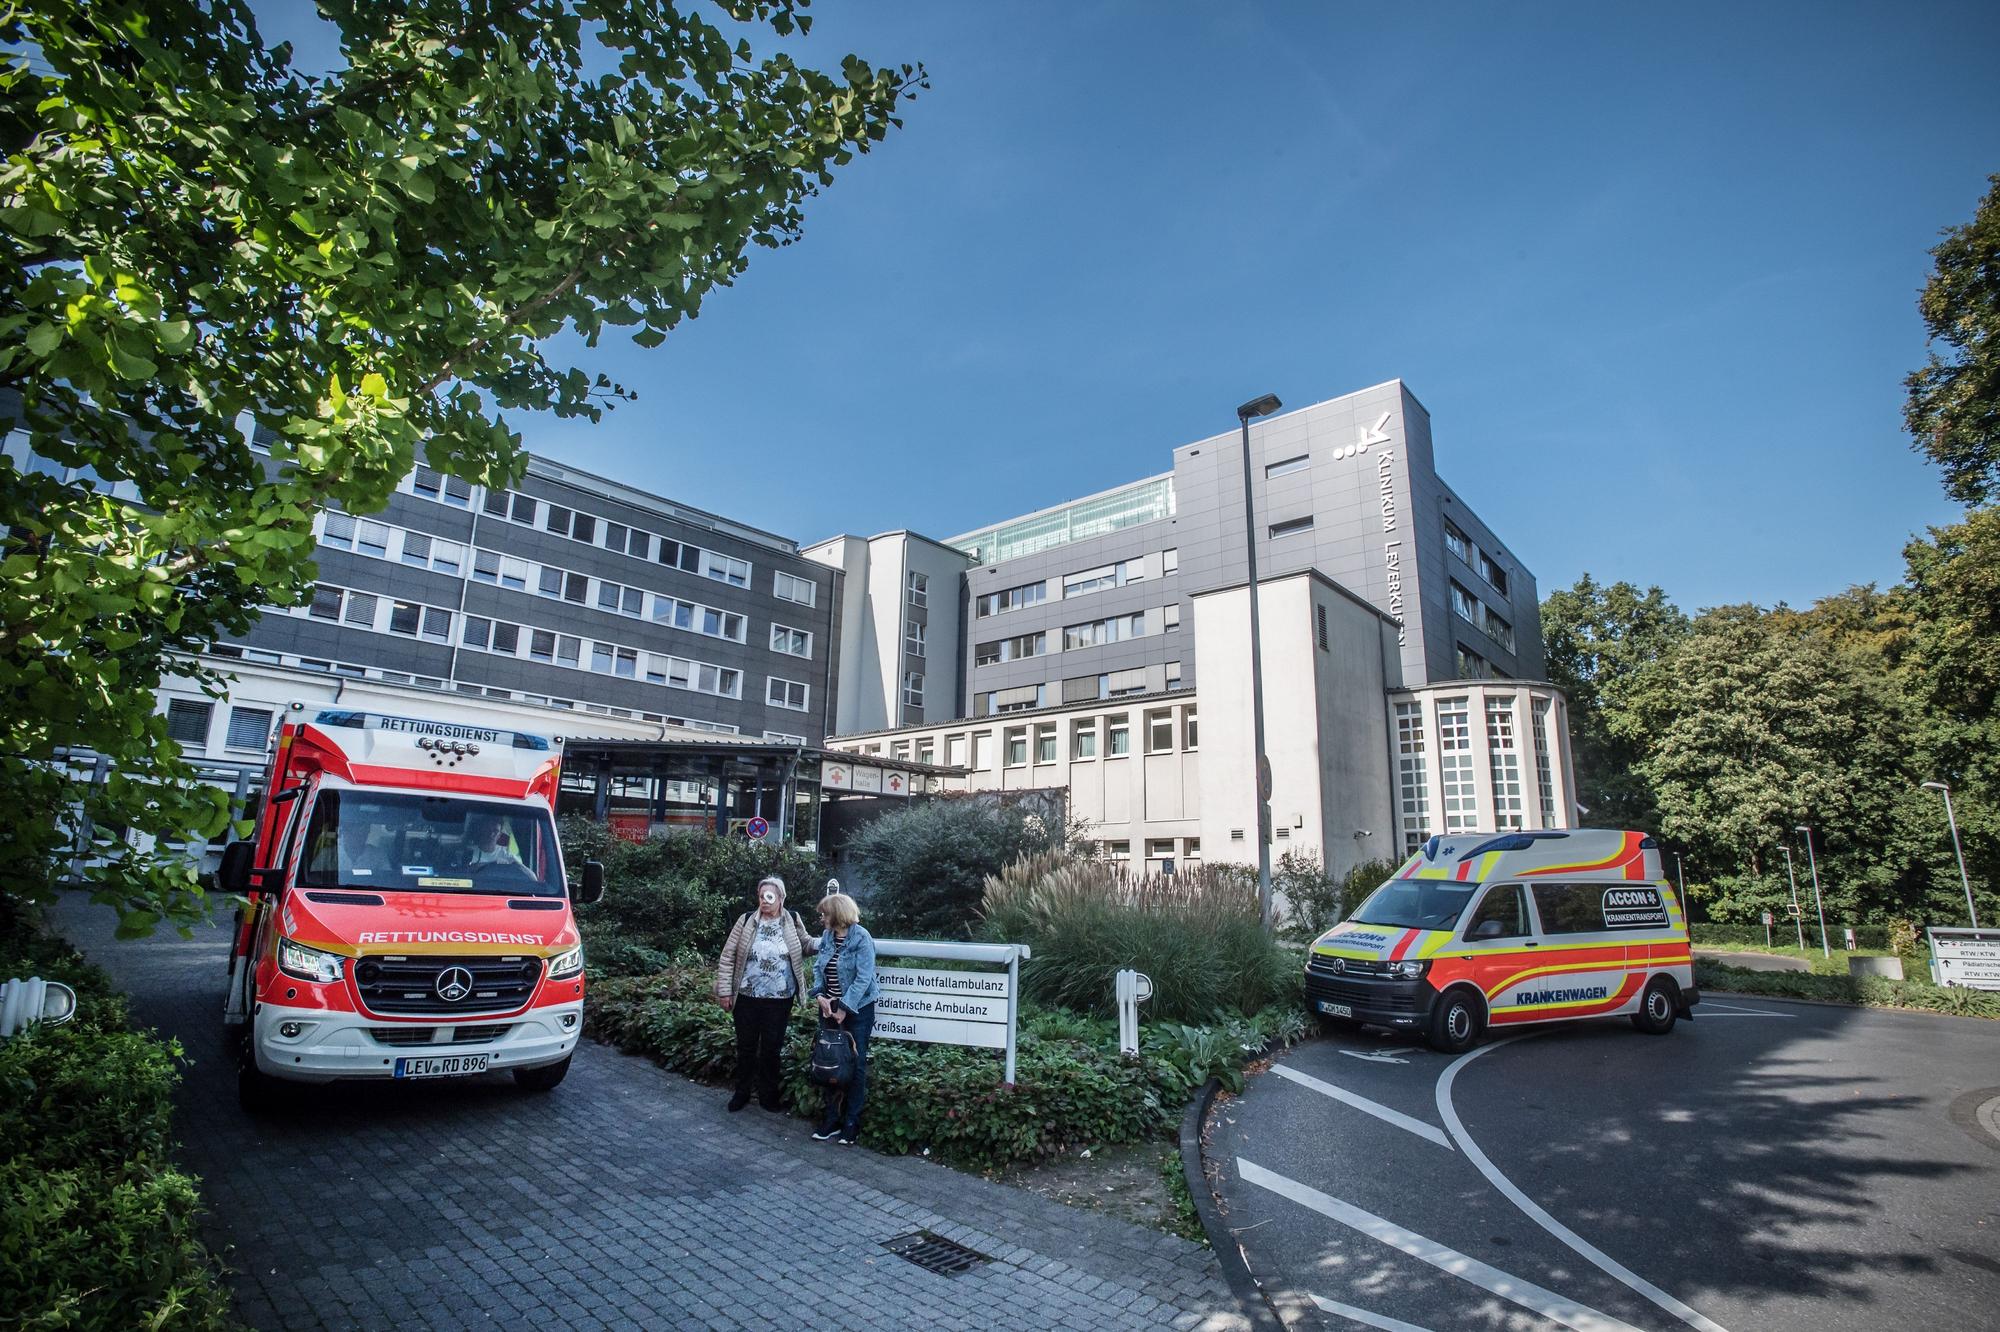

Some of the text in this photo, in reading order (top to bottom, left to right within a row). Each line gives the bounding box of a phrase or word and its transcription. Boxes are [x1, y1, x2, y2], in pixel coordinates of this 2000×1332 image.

[1378, 449, 1396, 533] KLINIKUM
[380, 717, 499, 743] RETTUNGSDIENST
[1608, 891, 1648, 906] ACCON
[1606, 912, 1665, 922] KRANKENTRANSPORT
[358, 931, 544, 945] RETTUNGSDIENST
[917, 975, 1004, 992] Notfallambulanz
[1516, 986, 1607, 1005] KRANKENWAGEN
[934, 1001, 988, 1016] Ambulanz
[405, 1056, 486, 1075] LEV RD 896
